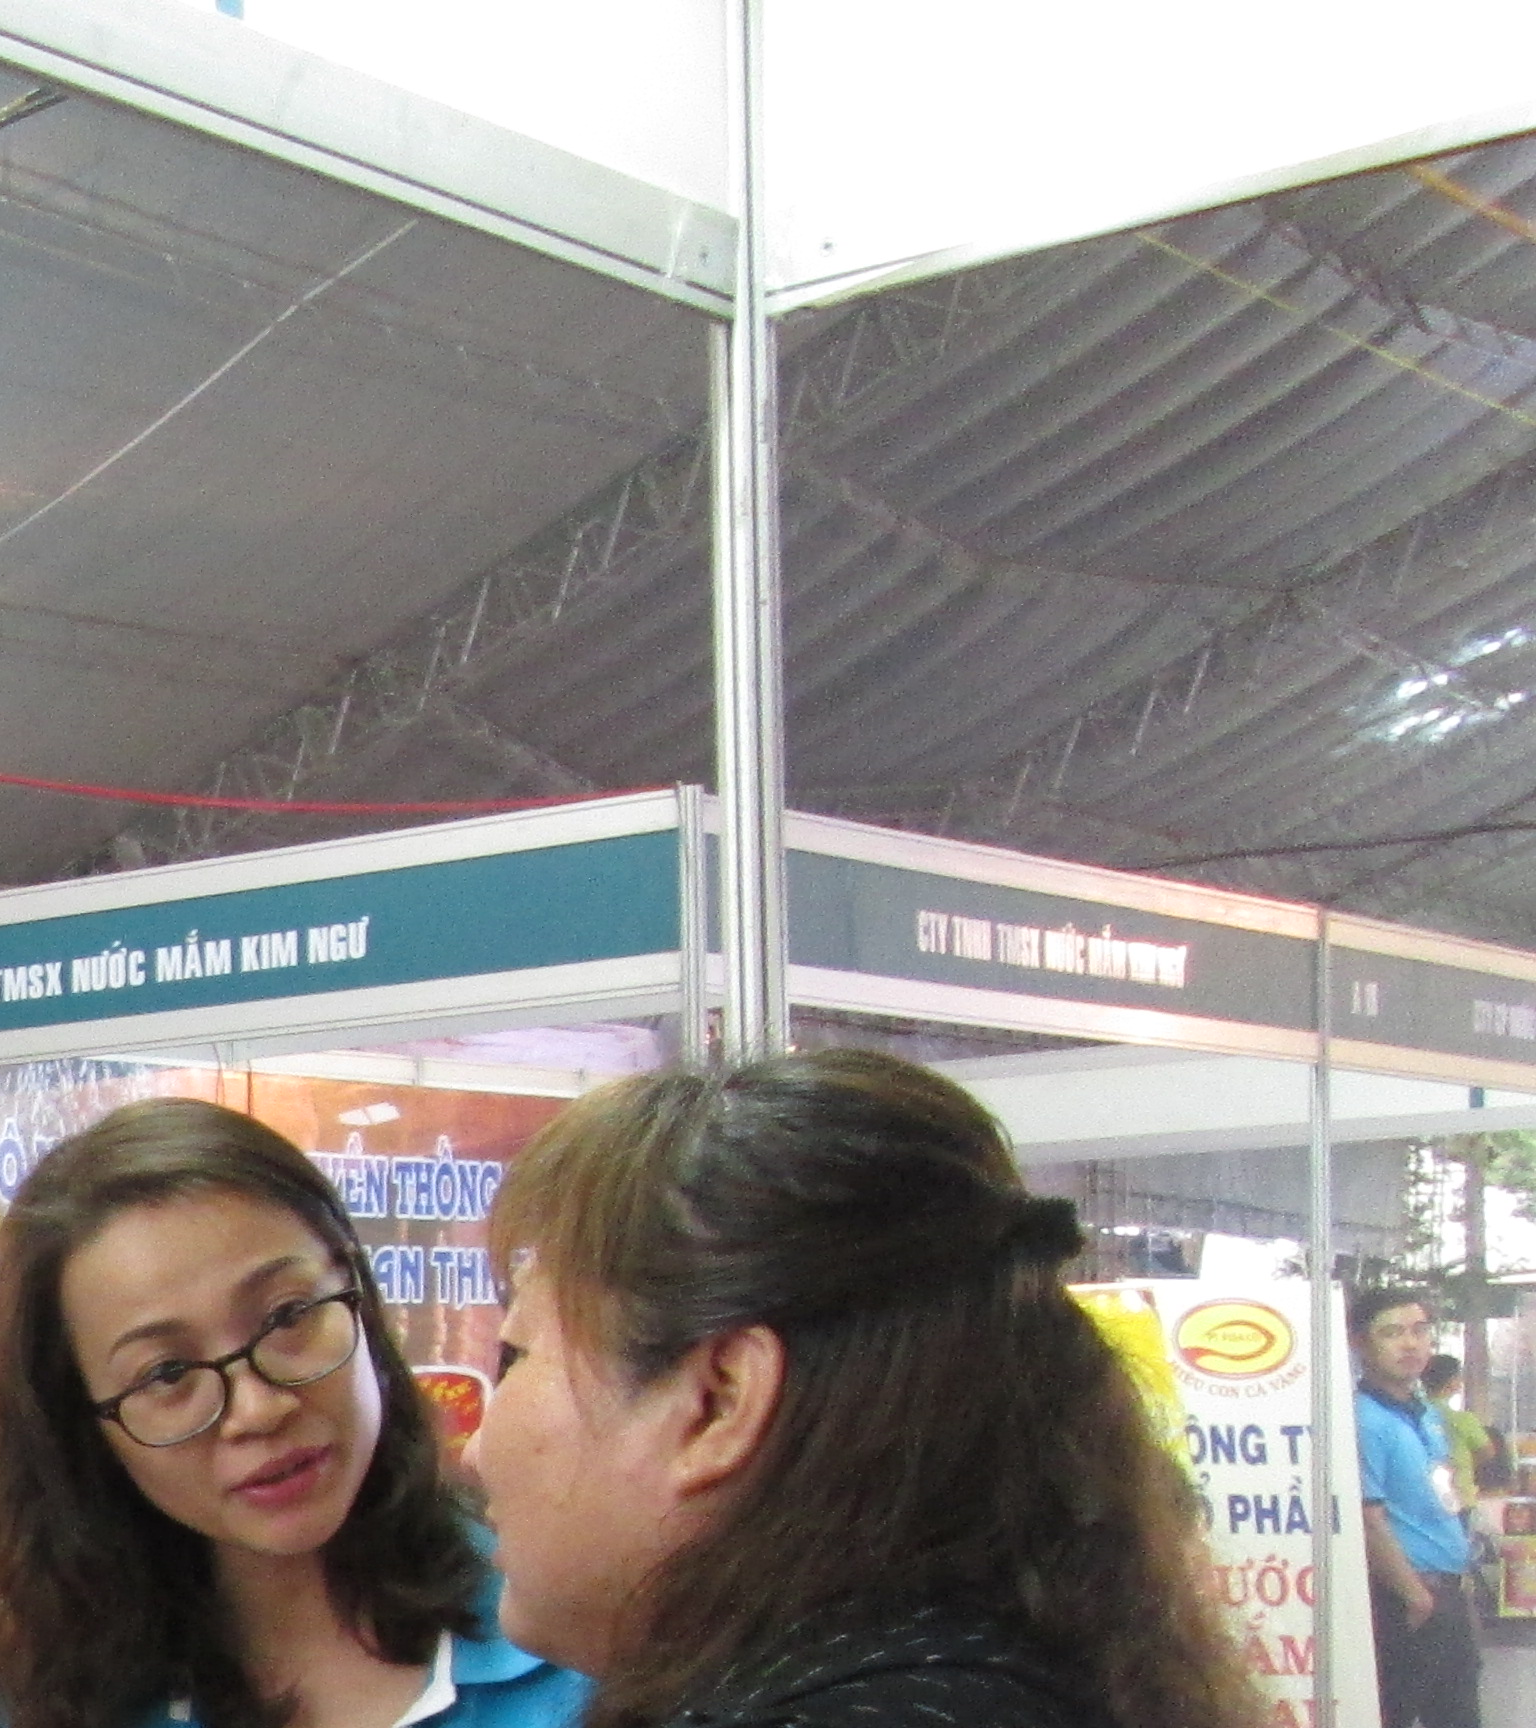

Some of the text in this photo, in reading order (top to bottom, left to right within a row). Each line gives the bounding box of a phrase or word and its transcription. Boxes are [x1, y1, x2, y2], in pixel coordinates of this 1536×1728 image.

[72, 940, 146, 994] NƯỚC
[155, 929, 231, 982] MẮM
[241, 930, 298, 972] KIM
[307, 915, 369, 965] NGƯ
[1183, 1414, 1314, 1466] ÔNG T
[1216, 1552, 1317, 1607] ƯỚC
